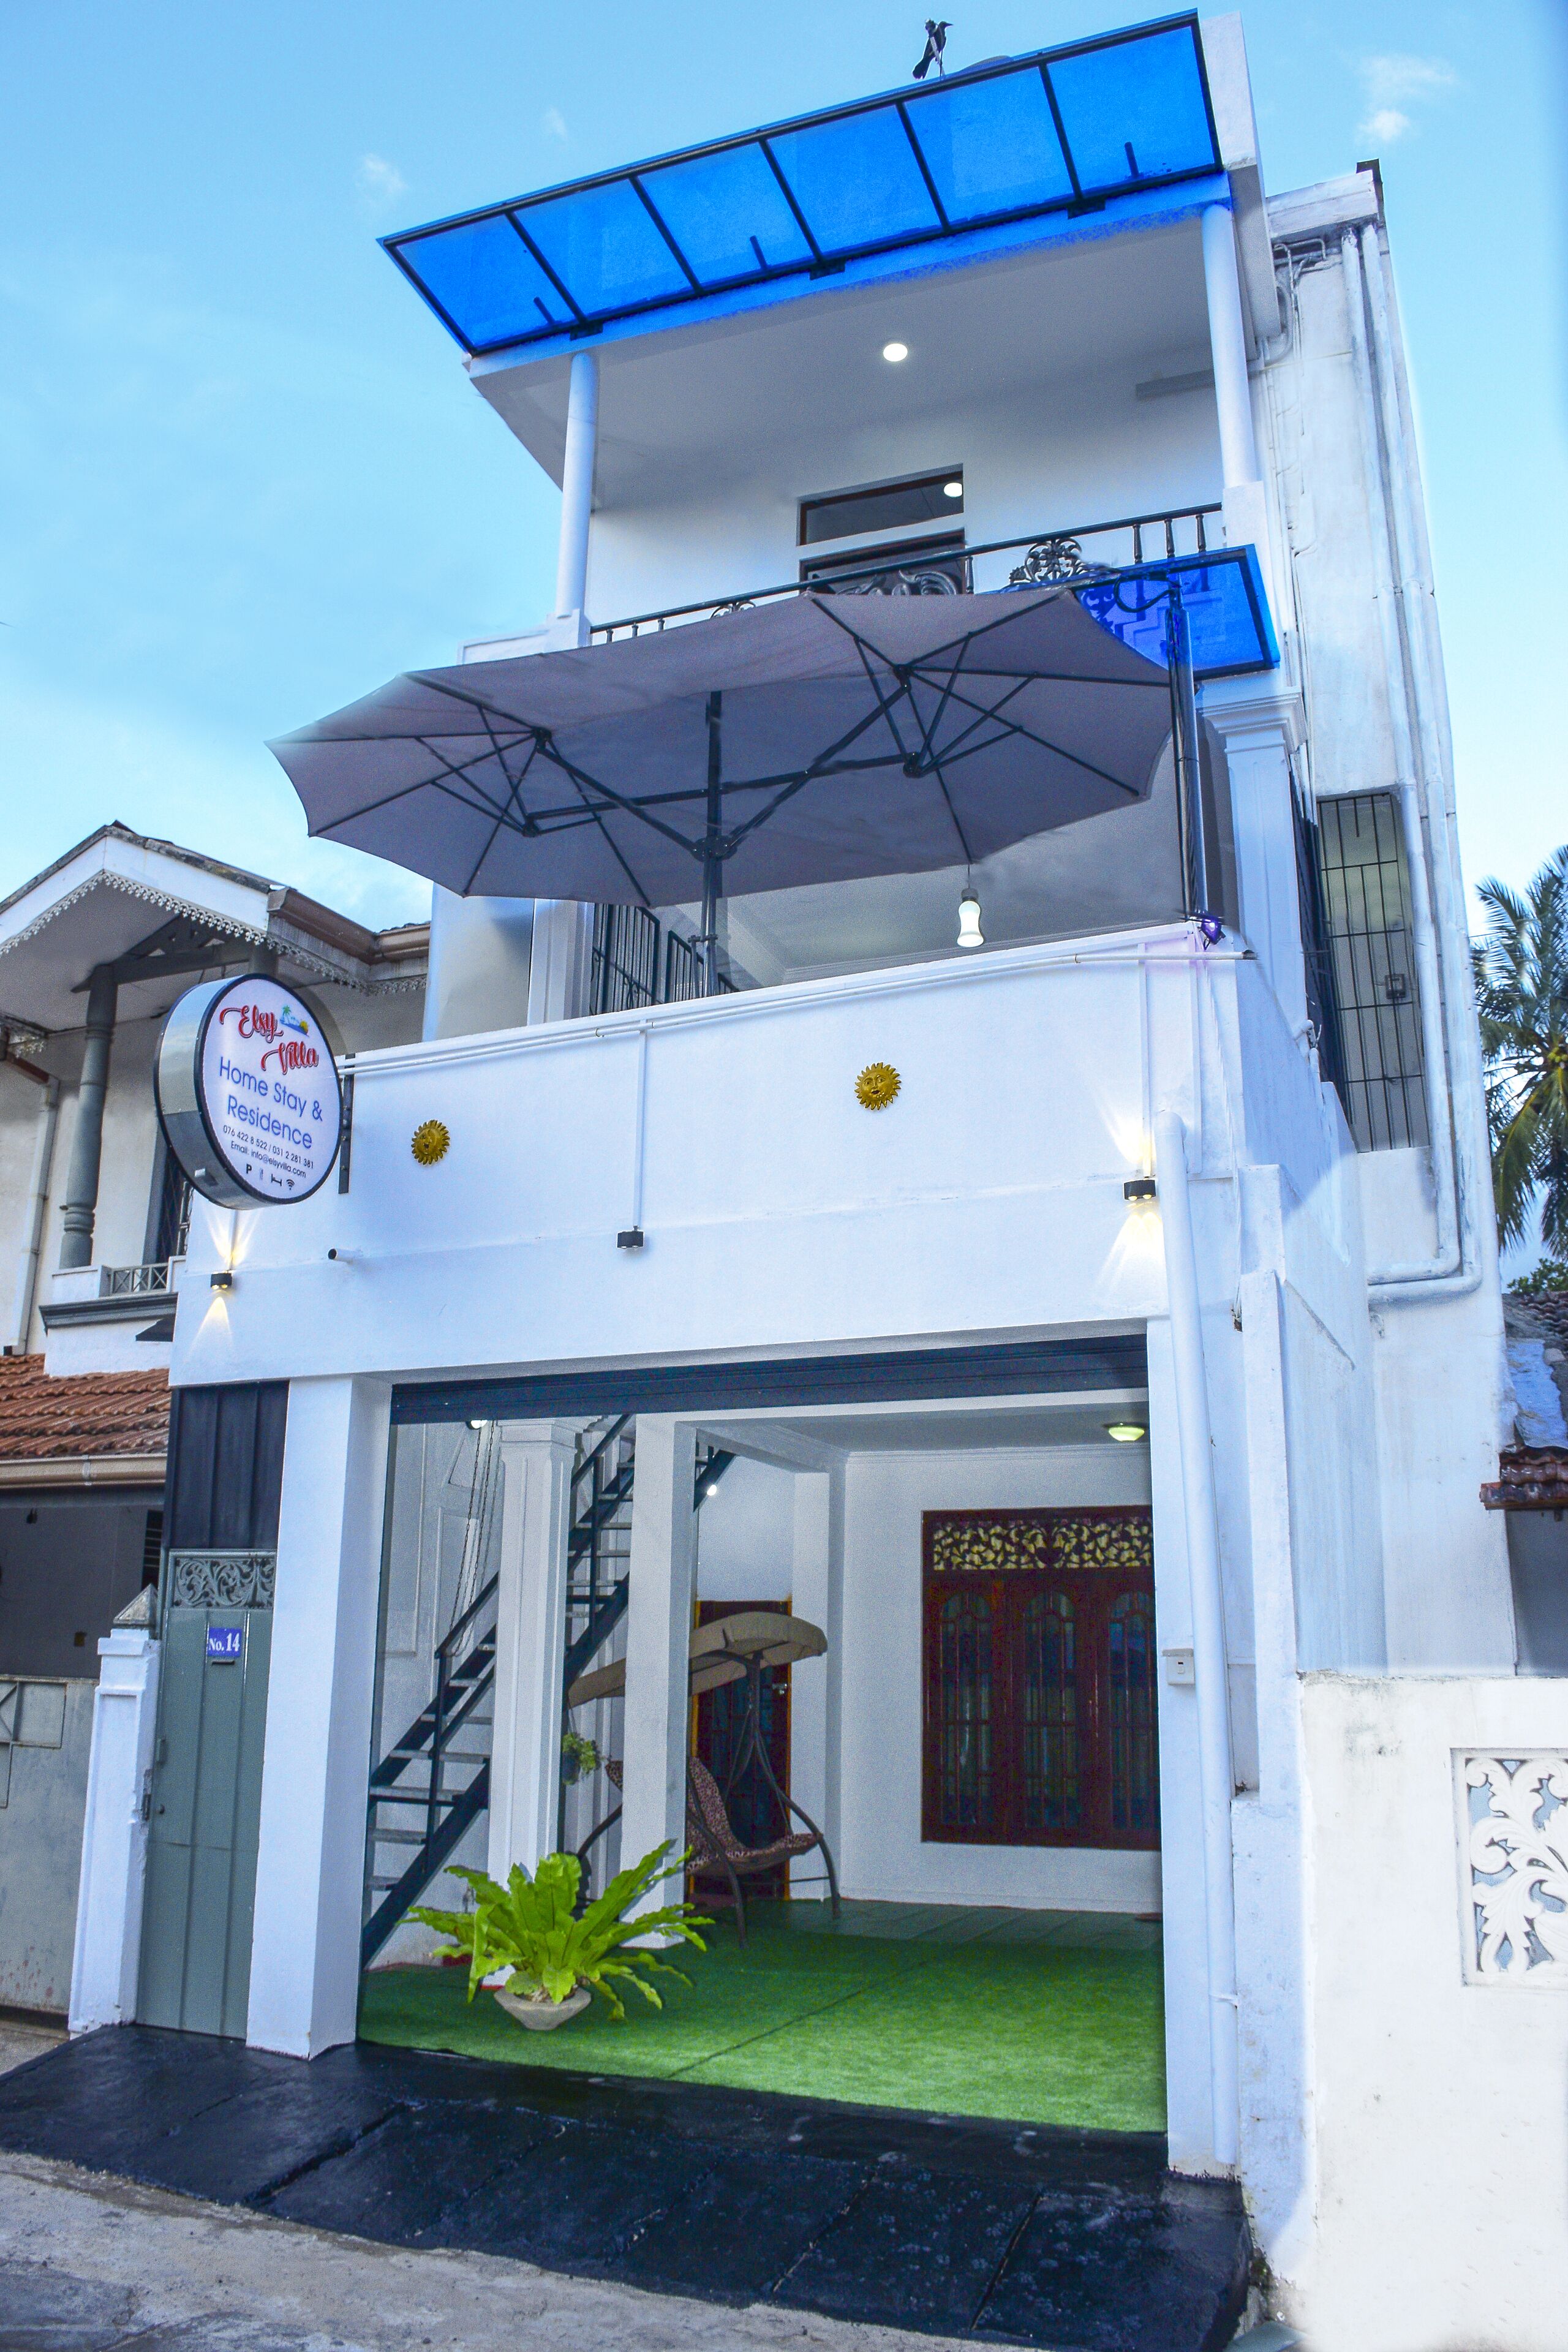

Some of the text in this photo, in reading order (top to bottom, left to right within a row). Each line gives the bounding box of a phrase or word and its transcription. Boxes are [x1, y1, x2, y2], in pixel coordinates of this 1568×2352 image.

[219, 1005, 284, 1043] Elsy
[261, 1041, 319, 1075] Villa
[219, 1057, 323, 1121] Home Stay &
[228, 1094, 312, 1149] Residence
[223, 1125, 235, 1136] 076
[237, 1131, 249, 1142] 422
[251, 1136, 254, 1145] 8
[256, 1139, 267, 1150] 522
[273, 1146, 283, 1156] 031
[291, 1153, 301, 1164] 281
[303, 1158, 314, 1169] 381
[231, 1140, 306, 1178] Email: info@elsyvilla.com
